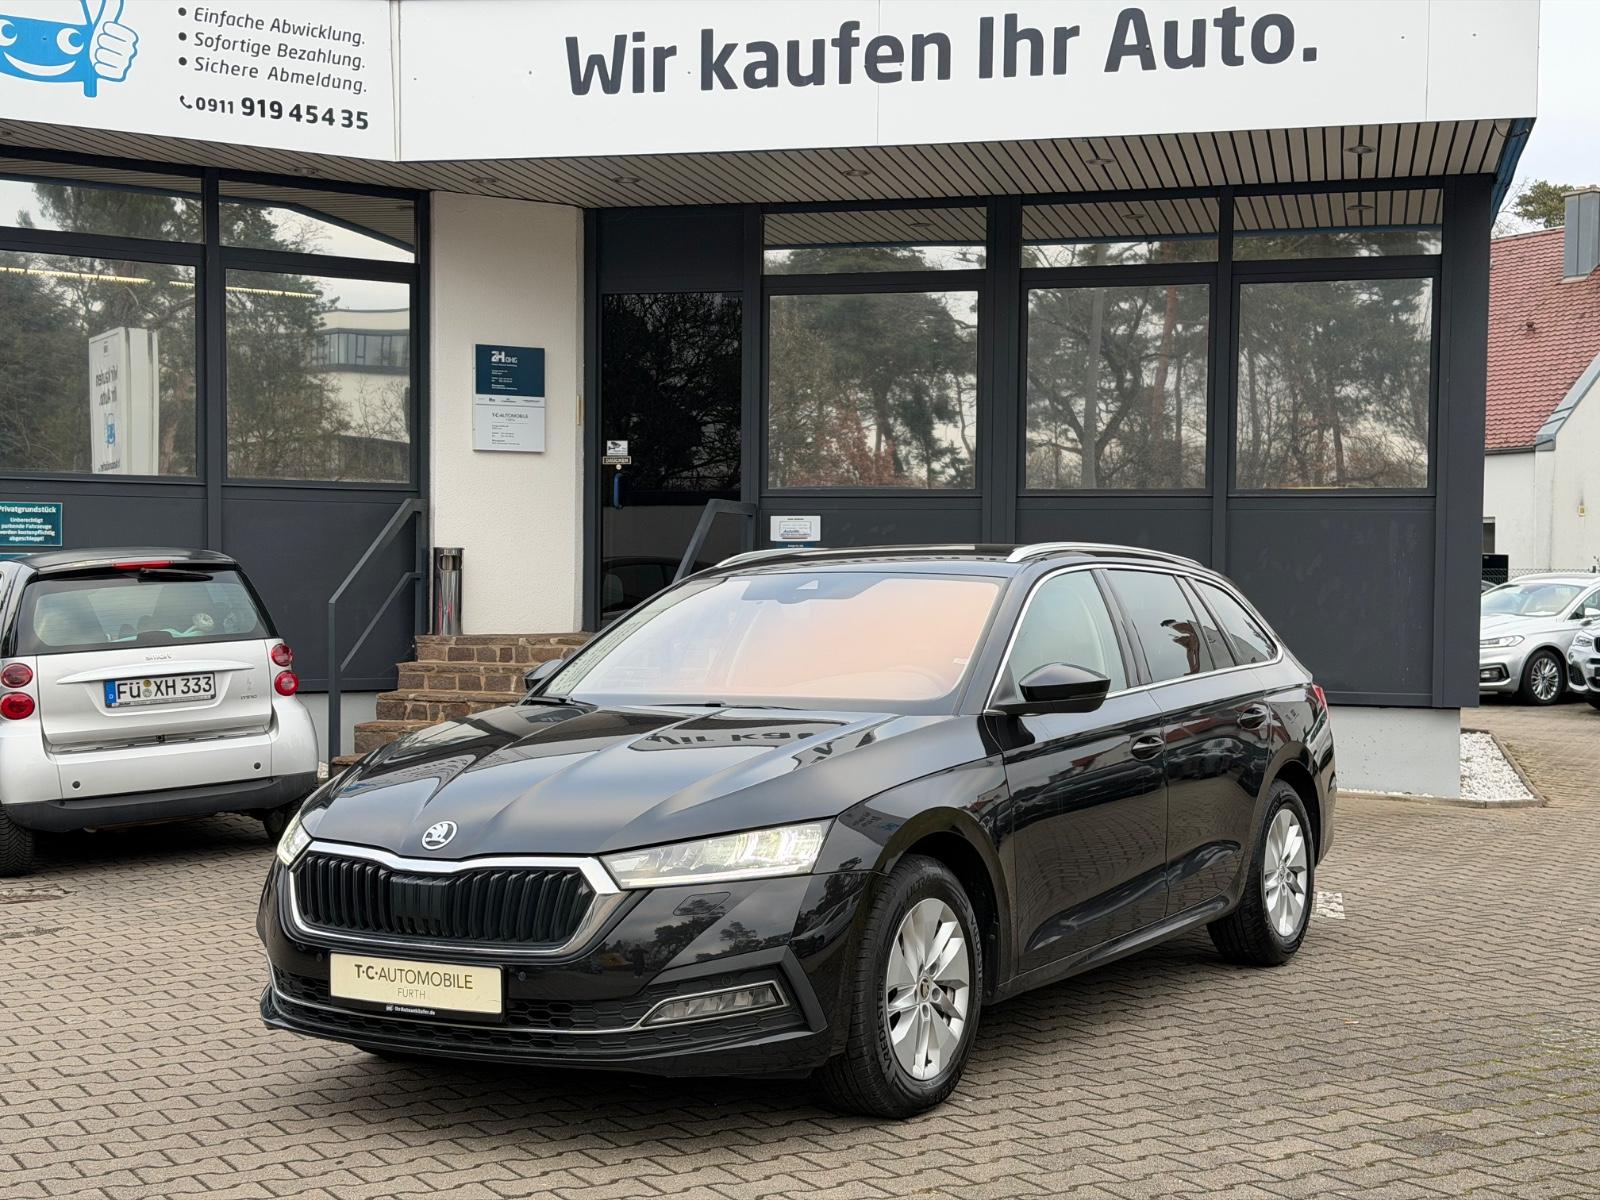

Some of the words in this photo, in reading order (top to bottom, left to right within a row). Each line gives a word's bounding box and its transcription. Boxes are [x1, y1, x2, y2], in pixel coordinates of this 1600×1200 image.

[194, 7, 265, 31] Einfache
[269, 17, 366, 47] Abwicklung.
[194, 32, 271, 57] Sofortige
[277, 43, 366, 70] Bezahlung.
[565, 30, 677, 96] Wir
[700, 20, 951, 92] kaufen
[978, 13, 1081, 79] Ihr
[1104, 7, 1318, 73] Auto.
[194, 57, 260, 79] Sichere
[267, 66, 367, 95] Abmeldung.
[195, 97, 234, 114] 0911
[241, 97, 283, 120] 919
[117, 681, 141, 700] FÜ
[153, 678, 177, 698] XH
[181, 676, 212, 695] 333
